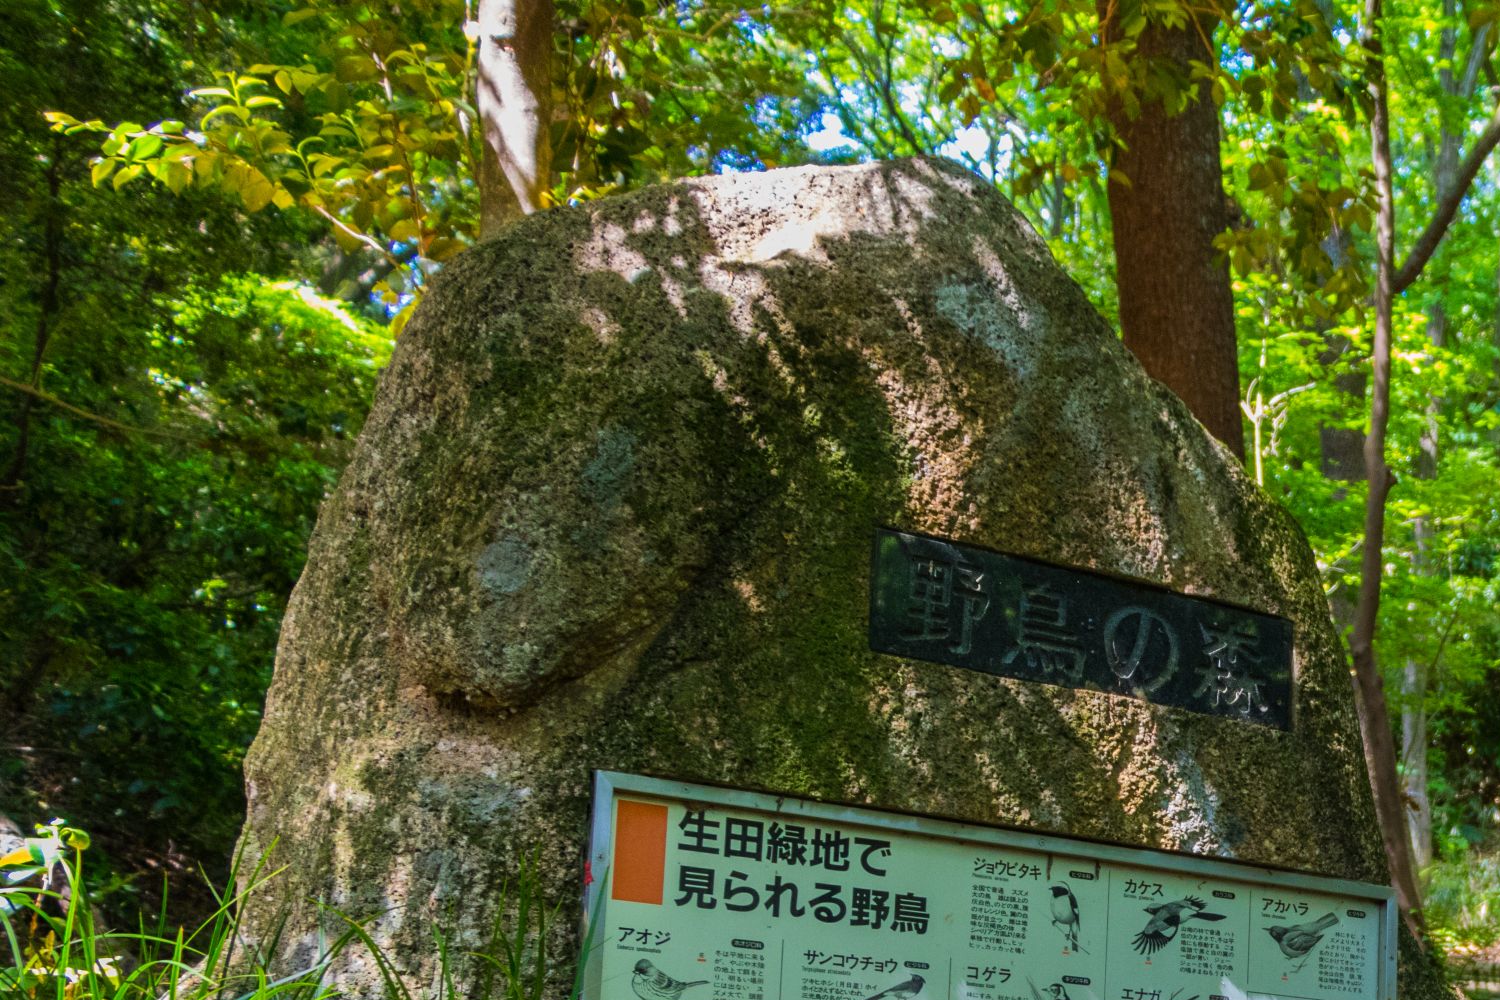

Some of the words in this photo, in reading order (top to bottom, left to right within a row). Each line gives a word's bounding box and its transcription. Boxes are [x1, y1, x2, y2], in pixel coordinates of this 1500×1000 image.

[903, 554, 1269, 713] 野鳥の森
[678, 811, 892, 877] 生田緑地で
[974, 857, 1041, 880] ジョウビタキ
[675, 864, 930, 934] 見られる野鳥
[1125, 879, 1163, 896] カケス
[1262, 898, 1308, 915] アカハラ
[618, 926, 671, 945] アオジ
[803, 950, 898, 973] サンコウチョウ
[967, 966, 1011, 983] コゲラ
